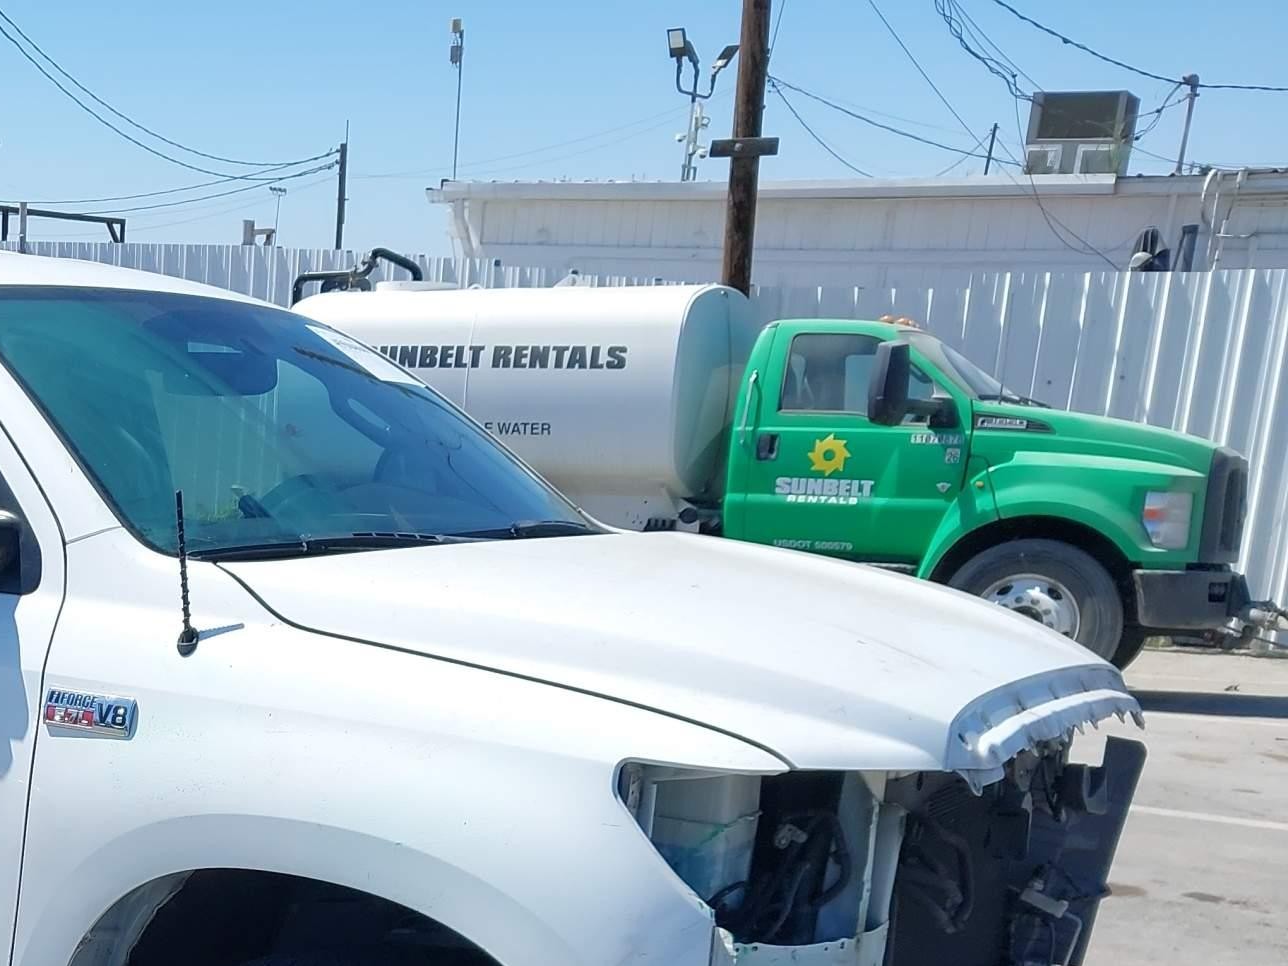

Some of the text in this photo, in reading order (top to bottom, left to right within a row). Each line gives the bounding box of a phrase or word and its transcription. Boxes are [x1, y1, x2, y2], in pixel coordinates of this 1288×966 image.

[372, 345, 485, 369] NBELT
[491, 345, 628, 370] RENTALS
[497, 422, 551, 436] WATER
[775, 477, 874, 497] SUNBELT
[786, 494, 858, 505] RENTALS
[96, 702, 128, 728] V8
